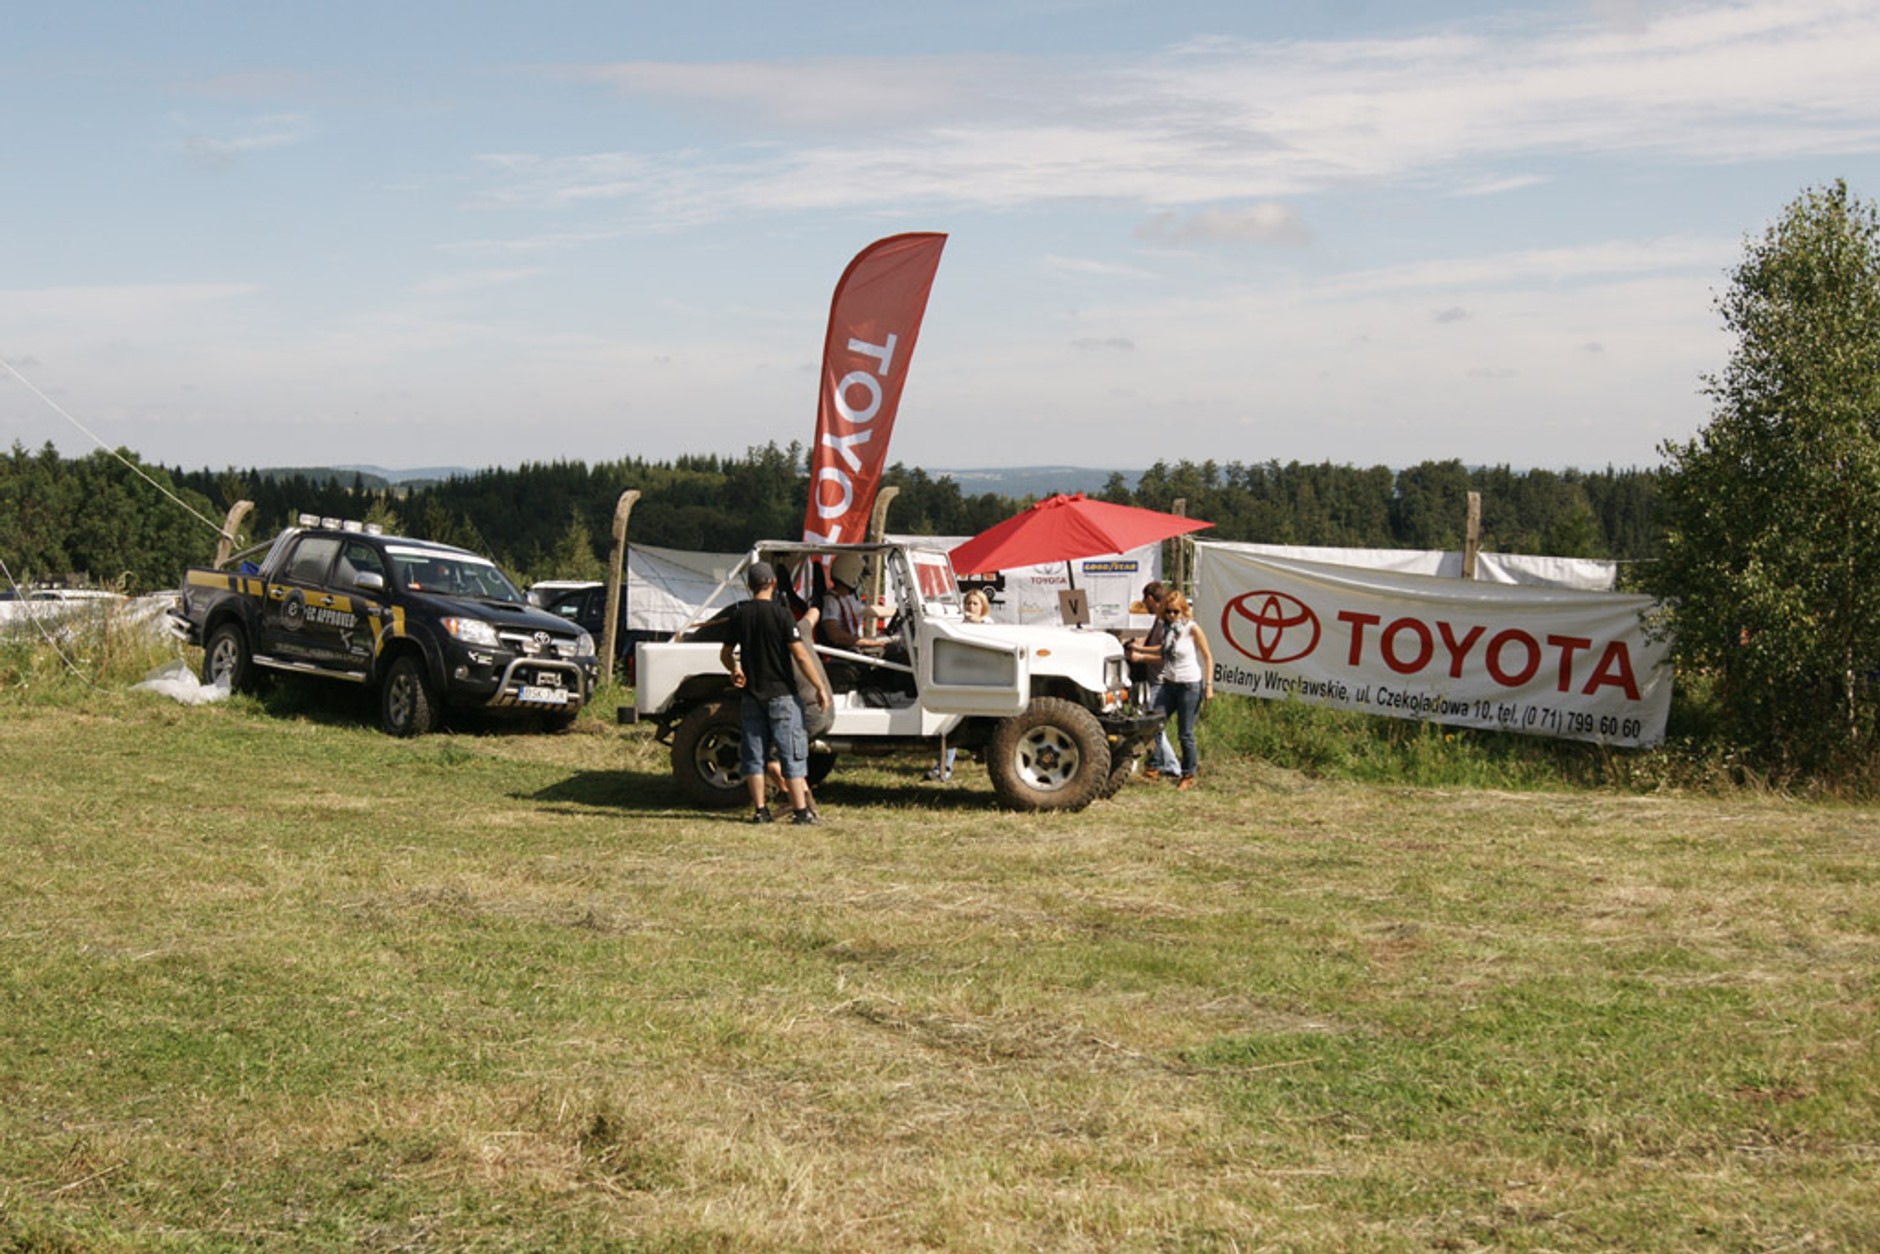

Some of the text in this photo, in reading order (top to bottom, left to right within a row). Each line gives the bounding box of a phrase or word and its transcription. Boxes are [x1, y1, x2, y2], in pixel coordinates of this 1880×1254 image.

[1031, 576, 1068, 586] TOYOTA
[1068, 600, 1079, 615] V
[317, 608, 355, 628] APPROVED
[1337, 610, 1641, 700] TOYOTA
[1214, 663, 1261, 692] Bielany
[1376, 686, 1469, 717] Czekoladowa
[1522, 706, 1537, 730] (0
[1541, 709, 1563, 734] 71)
[1567, 711, 1593, 732] 799
[1600, 716, 1618, 736] 60
[1623, 718, 1642, 739] 60
